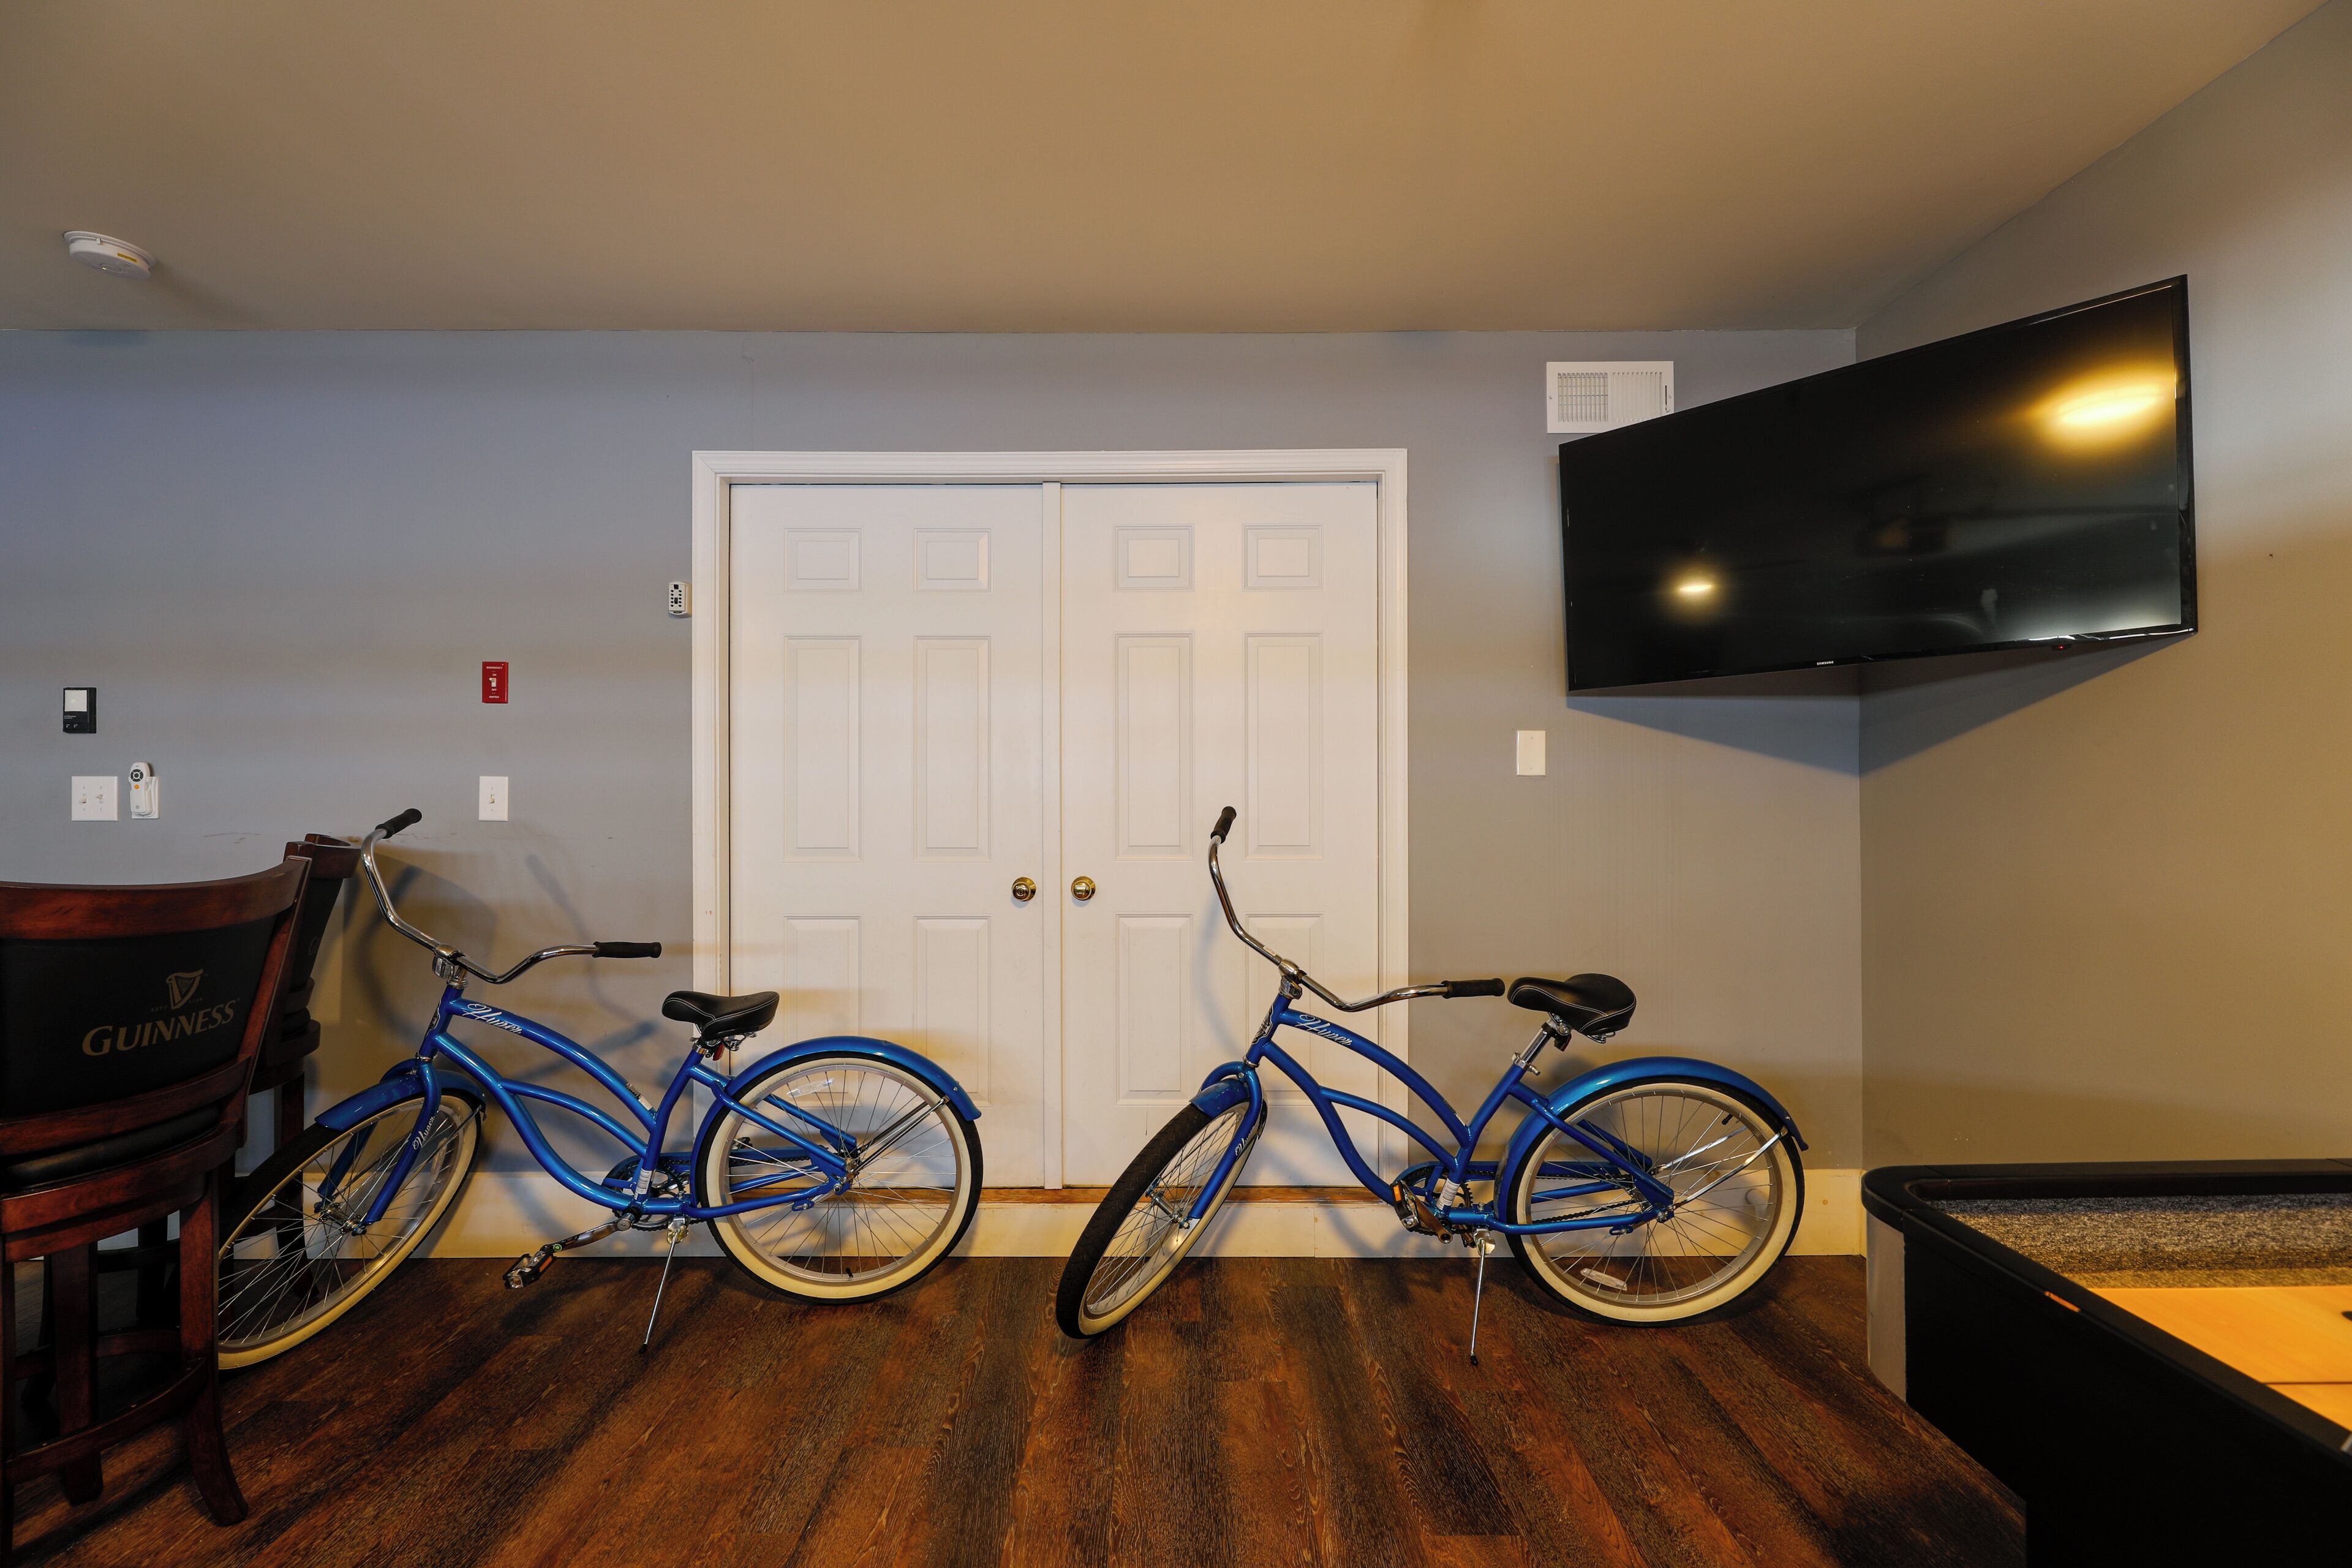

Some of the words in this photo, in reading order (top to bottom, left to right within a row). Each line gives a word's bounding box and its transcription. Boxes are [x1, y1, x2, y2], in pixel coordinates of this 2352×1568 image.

[81, 999, 236, 1056] GUINNESS
[462, 1003, 522, 1035] Hyper
[1294, 1014, 1353, 1046] Hyper
